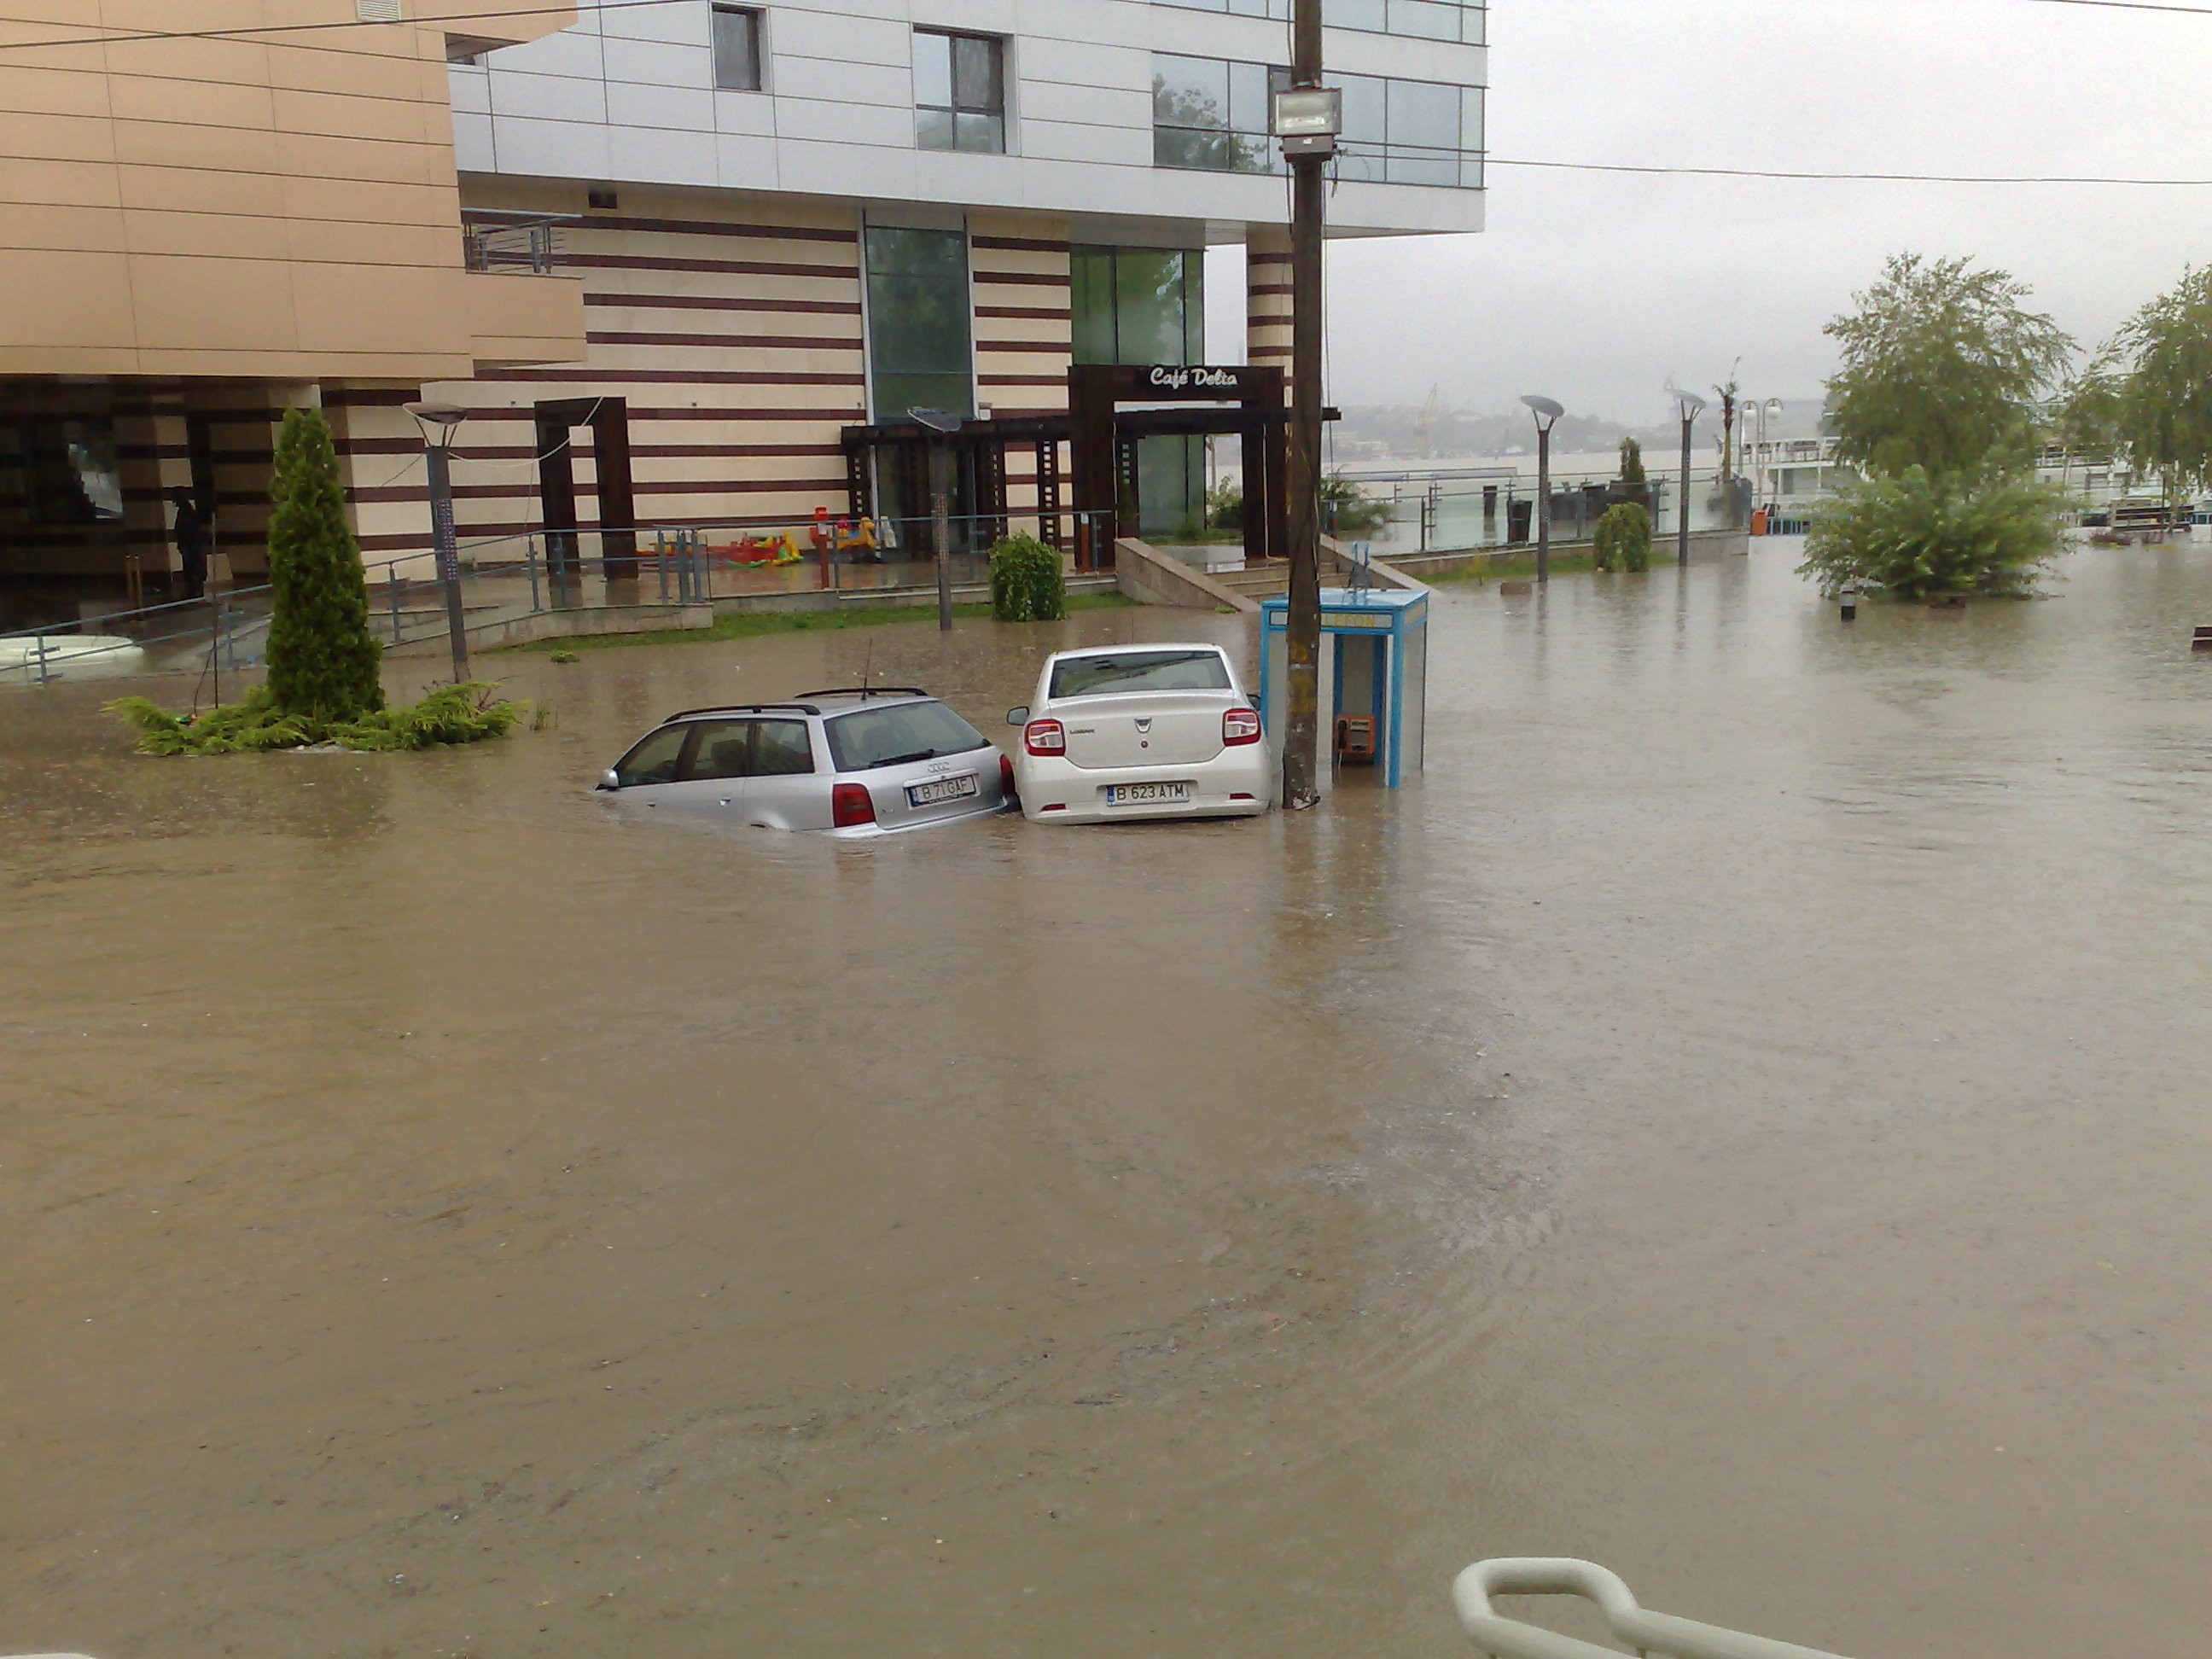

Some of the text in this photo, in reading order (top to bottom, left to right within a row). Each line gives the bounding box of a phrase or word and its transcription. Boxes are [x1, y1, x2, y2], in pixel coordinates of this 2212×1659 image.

[1150, 366, 1238, 390] Café Delta
[922, 785, 931, 800] B
[1116, 783, 1184, 800] B 623 ATM
